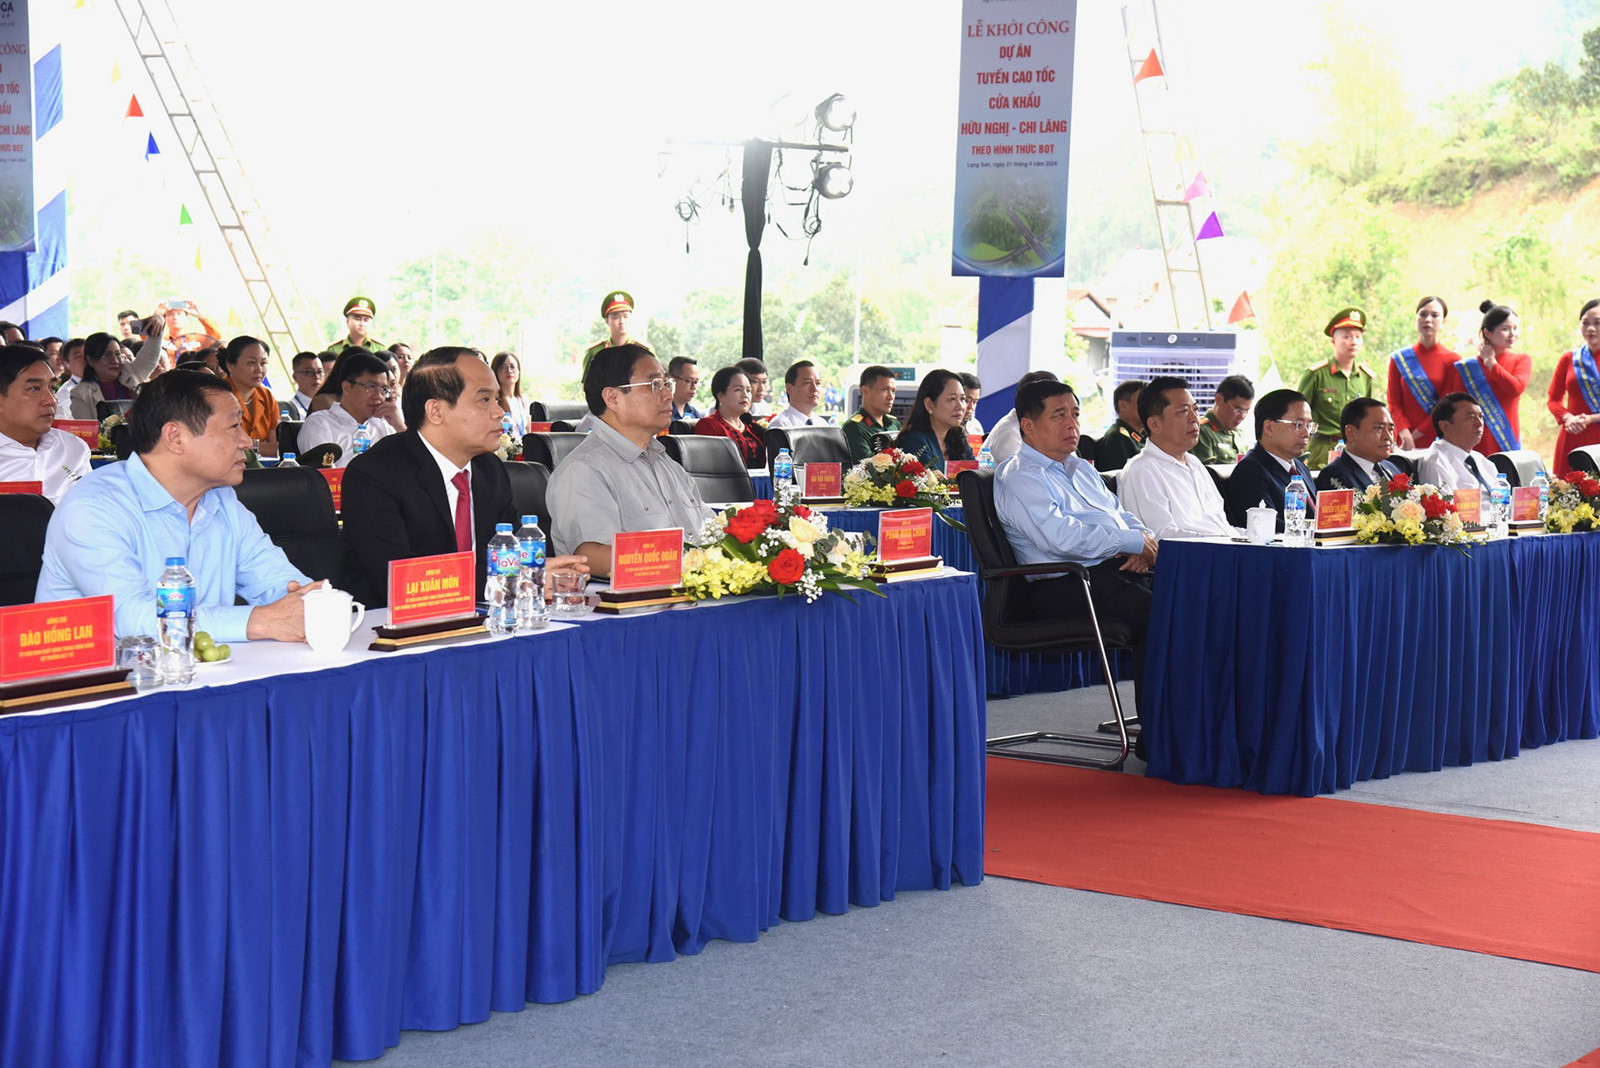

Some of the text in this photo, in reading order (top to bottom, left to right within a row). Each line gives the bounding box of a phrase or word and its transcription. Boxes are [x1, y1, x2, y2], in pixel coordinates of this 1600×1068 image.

[967, 18, 1070, 37] LỄ KHỞI CÔNG
[999, 43, 1031, 61] DỰ ÁN
[977, 65, 1056, 84] TUYẾN CAO TỐC
[988, 91, 1041, 109] CỬA KHẨU
[961, 120, 982, 135] HỮU
[984, 122, 1010, 136] NGHỊ
[1019, 121, 1037, 134] CHI
[1039, 119, 1068, 133] LĂNG
[971, 143, 1055, 155] THEO HÌNH THỨC BOT
[406, 581, 419, 597] LẠI
[420, 577, 441, 593] XUÂN
[441, 574, 459, 590] MÔN
[20, 629, 41, 647] ĐÀO
[73, 624, 93, 640] LAN
